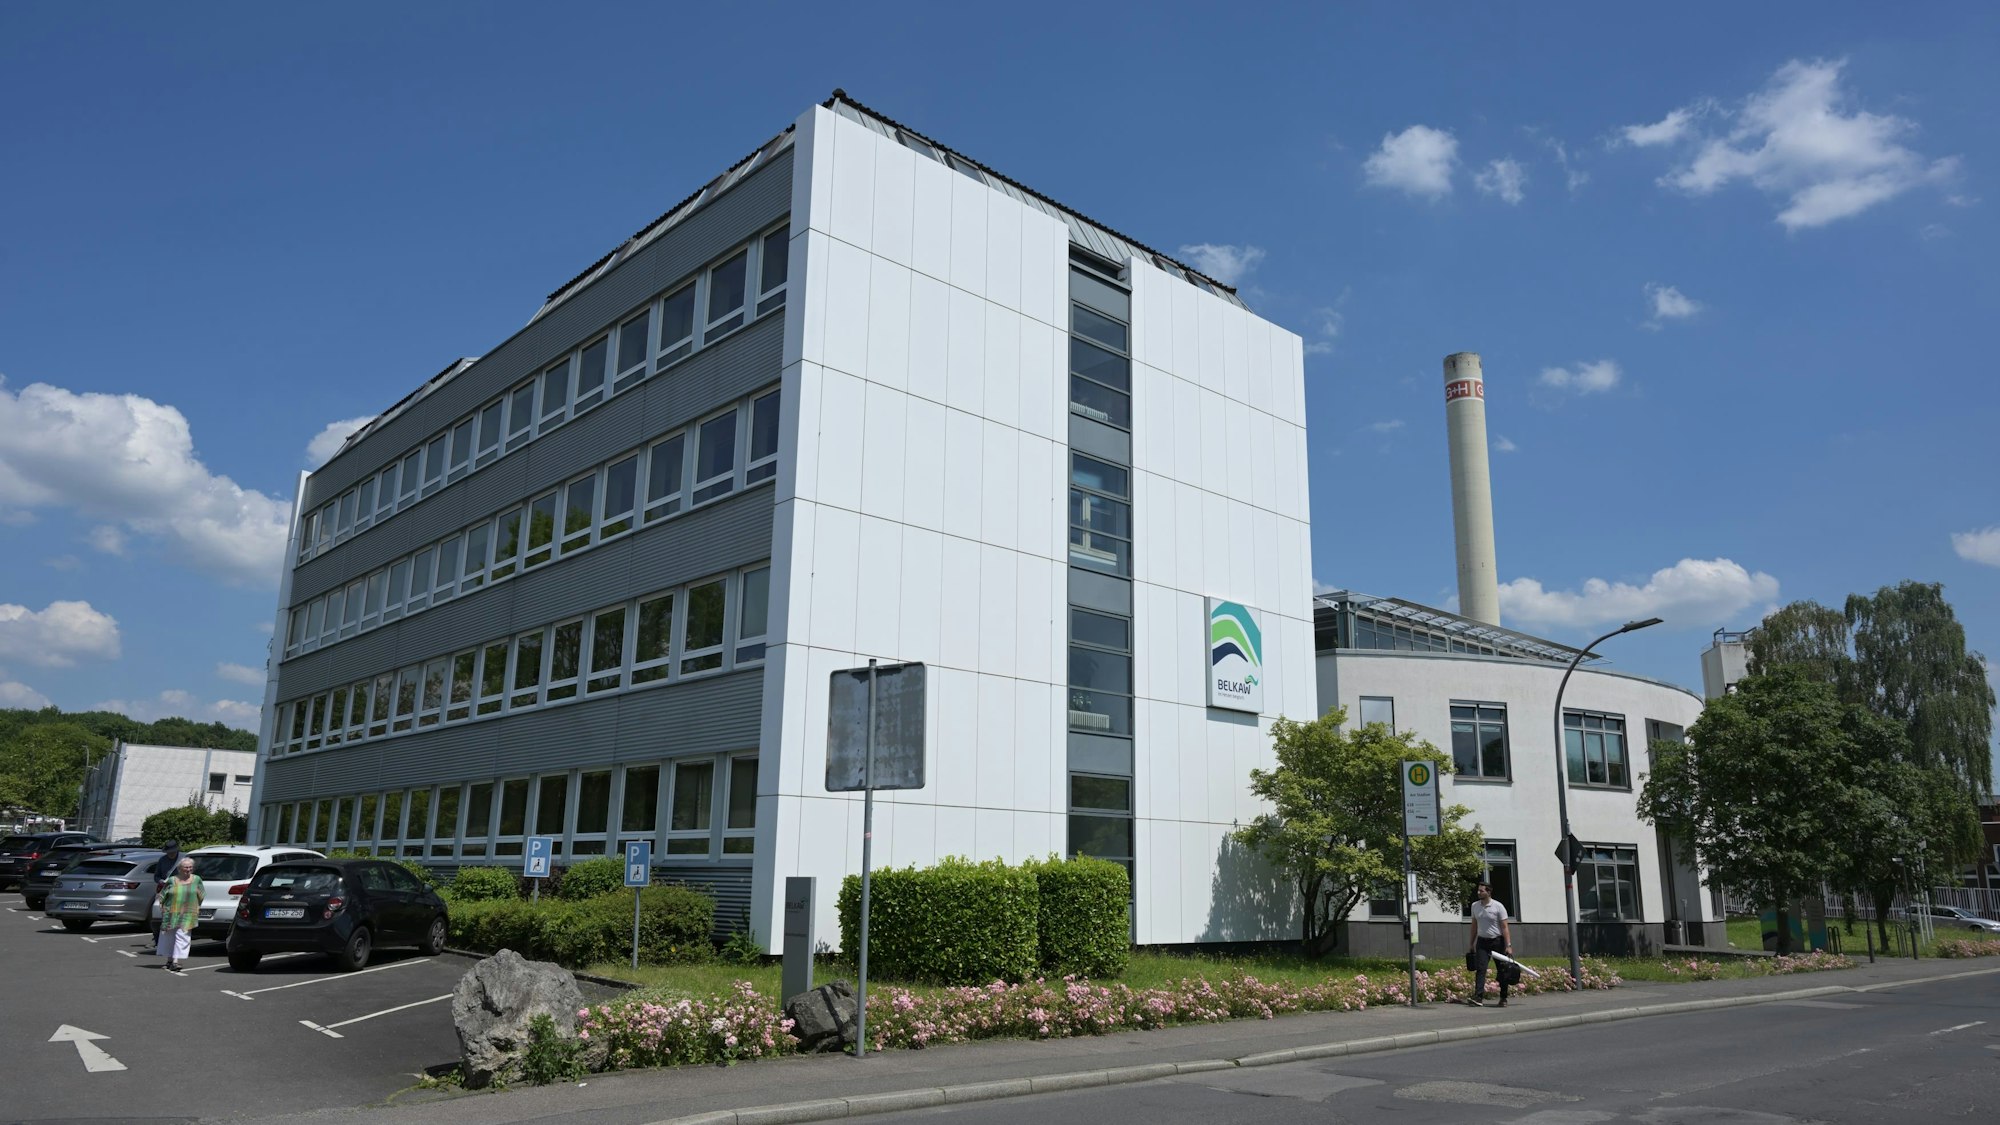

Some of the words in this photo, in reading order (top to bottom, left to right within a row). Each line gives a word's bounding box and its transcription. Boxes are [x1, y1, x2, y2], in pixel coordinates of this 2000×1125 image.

[1217, 678, 1251, 695] BELKAW
[1414, 768, 1424, 782] H
[531, 841, 541, 856] P
[630, 845, 640, 862] P
